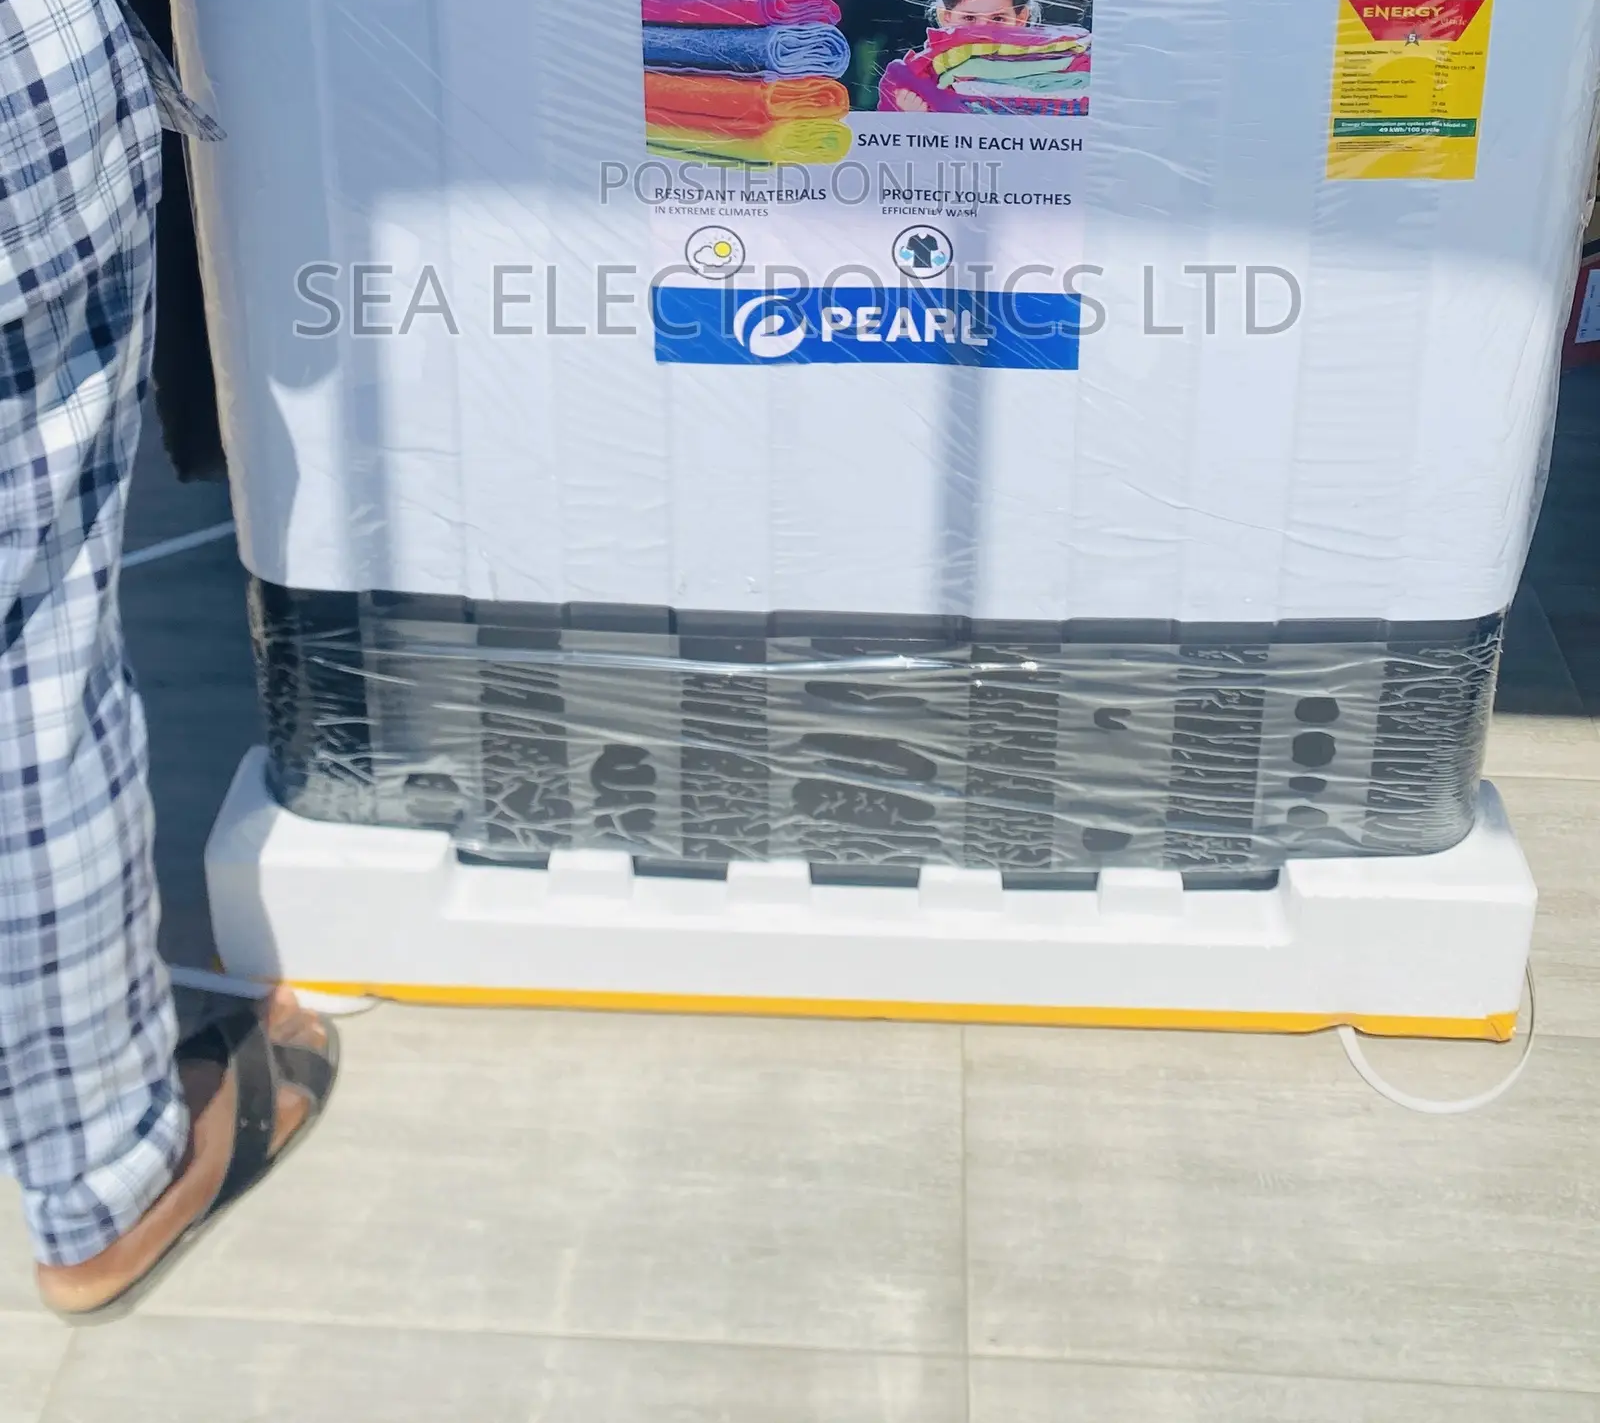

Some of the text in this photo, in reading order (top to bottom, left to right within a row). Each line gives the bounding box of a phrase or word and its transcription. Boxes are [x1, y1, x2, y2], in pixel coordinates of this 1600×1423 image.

[1363, 4, 1444, 21] ENERGY
[1408, 33, 1417, 43] 5
[856, 133, 1083, 151] SAVE TIME IN EACH WASH
[655, 188, 826, 202] RESISTANT MATERIALS
[882, 188, 1072, 206] PROTECT YOUR CLOTHES
[655, 206, 769, 217] IN EXTREME CLIMATES
[945, 209, 978, 218] WASH
[821, 306, 989, 346] PEARL
